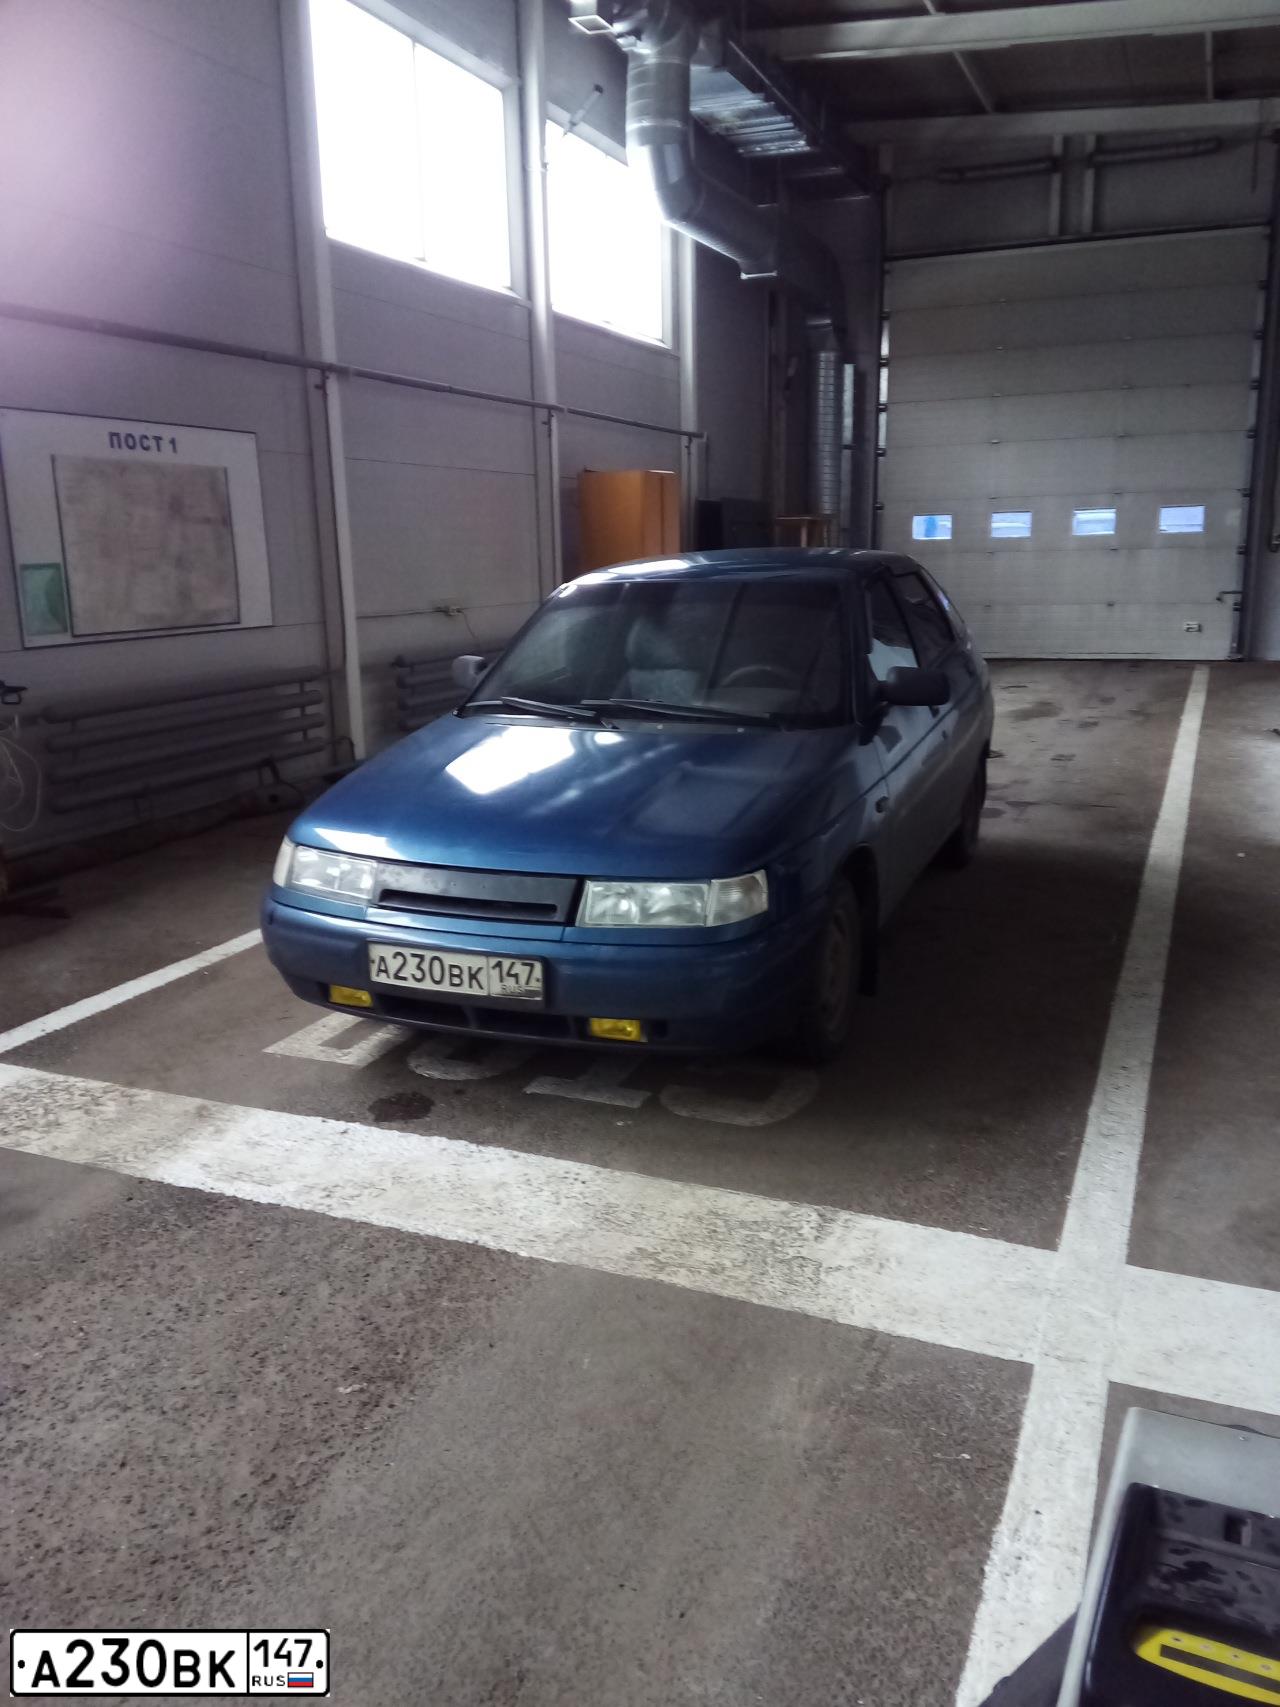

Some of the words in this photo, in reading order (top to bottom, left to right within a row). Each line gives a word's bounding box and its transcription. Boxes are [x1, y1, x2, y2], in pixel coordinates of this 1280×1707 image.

[108, 431, 163, 453] ПОСТ
[168, 437, 178, 454] 1
[491, 960, 536, 986] 147
